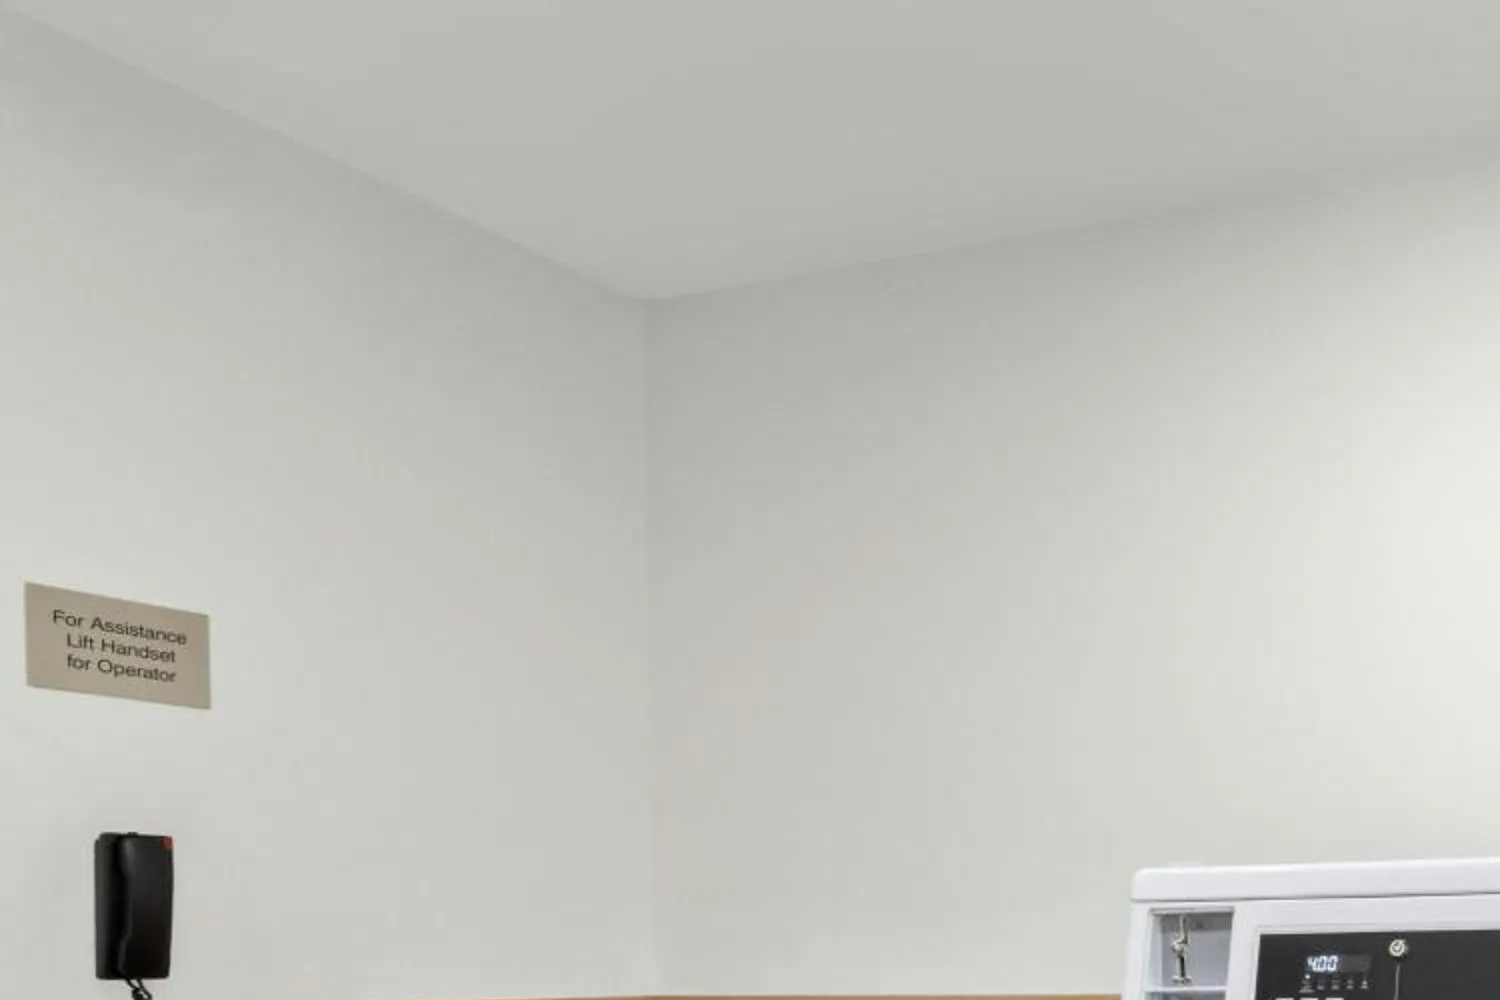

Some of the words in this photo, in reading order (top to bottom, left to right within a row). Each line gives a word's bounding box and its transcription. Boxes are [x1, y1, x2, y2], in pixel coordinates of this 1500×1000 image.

[52, 609, 84, 627] For
[90, 616, 188, 645] Assistance
[66, 633, 94, 650] Lift
[101, 638, 176, 663] Handset
[67, 653, 92, 670] for
[97, 659, 177, 683] Operator
